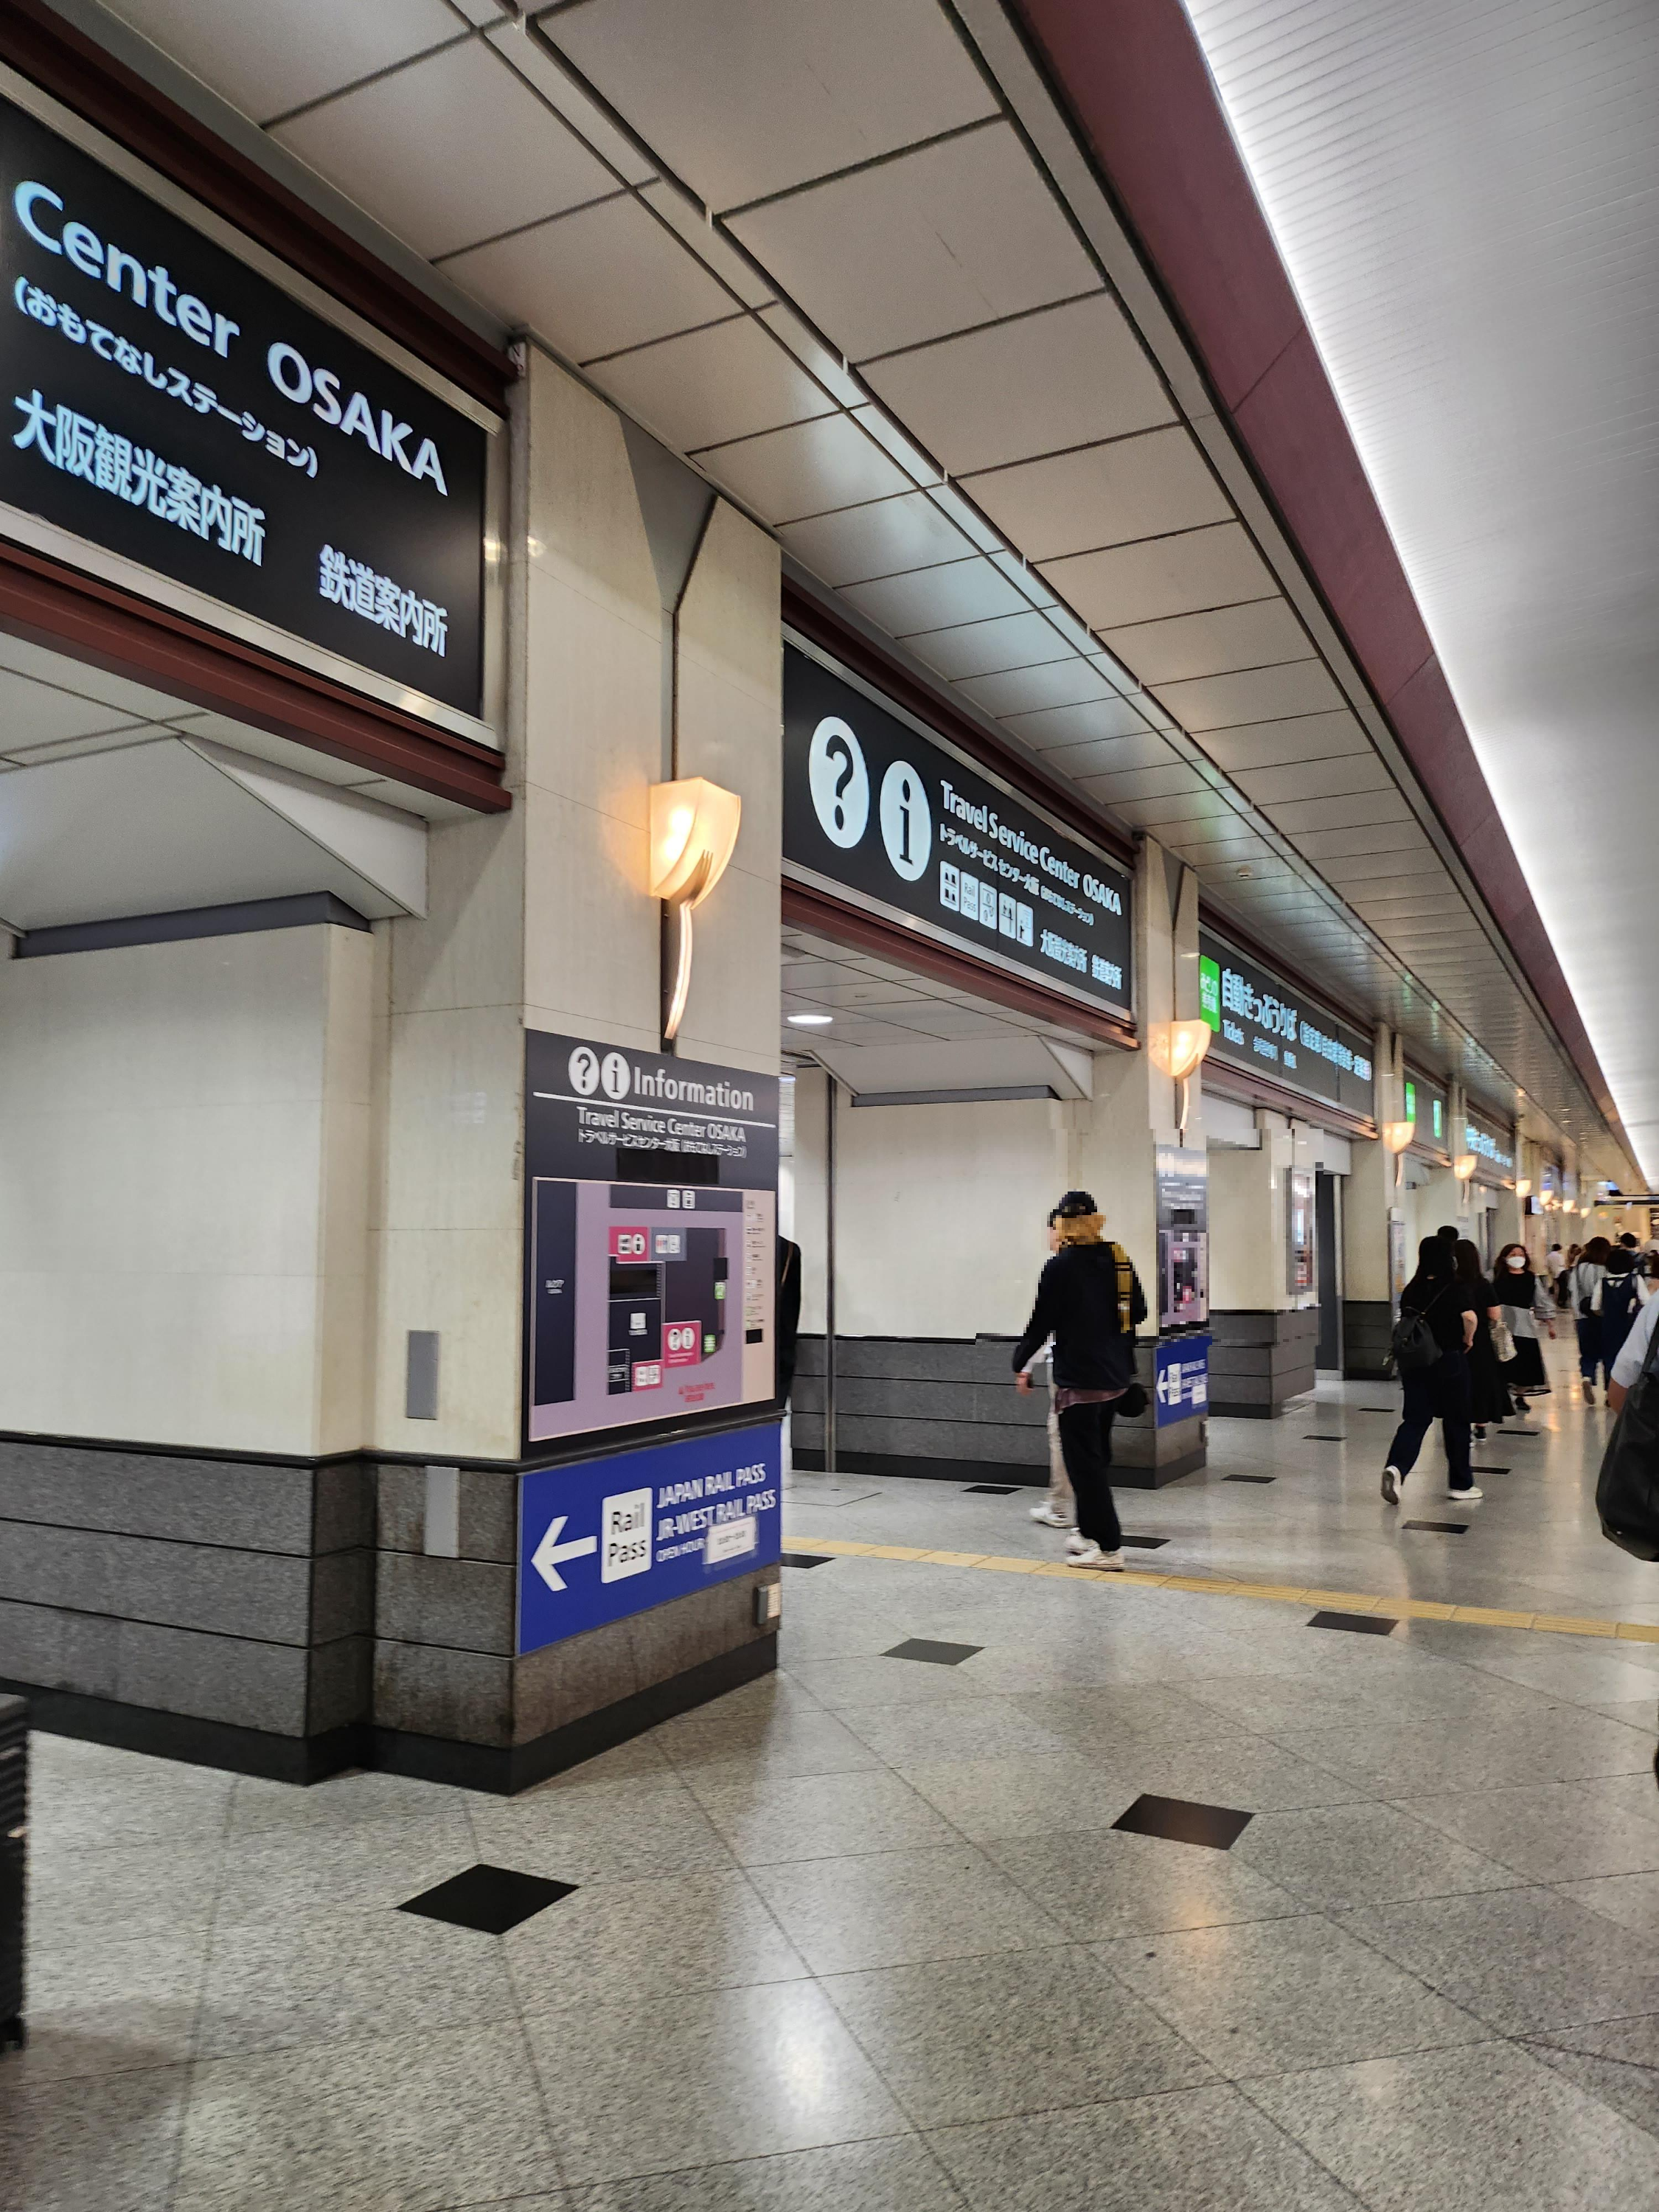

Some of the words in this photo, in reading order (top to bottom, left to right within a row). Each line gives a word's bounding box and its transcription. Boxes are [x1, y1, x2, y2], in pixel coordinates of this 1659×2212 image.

[15, 181, 240, 358] Center
[267, 341, 448, 497] OSAKA
[15, 276, 319, 479] (おもてなしステーション)
[14, 389, 266, 566] 大阪観光案内所
[319, 543, 448, 657] 鉄道案内所
[940, 780, 988, 833] Travel
[989, 813, 1039, 864] Service
[1040, 847, 1080, 889] Center
[1083, 874, 1122, 916] OSAKA
[634, 1066, 754, 1111] Information
[577, 1106, 619, 1128] Travel
[621, 1112, 666, 1133] Service
[667, 1118, 707, 1138] Center
[707, 1123, 746, 1142] OSAKA
[656, 1478, 703, 1509] JAPAN
[705, 1471, 735, 1495] RAIL
[736, 1463, 766, 1487] PASS
[611, 1501, 645, 1535] Rail
[655, 1506, 715, 1541] JR-WEST
[716, 1498, 746, 1524] RAIL
[746, 1489, 776, 1514] PASS
[607, 1539, 647, 1567] Pass
